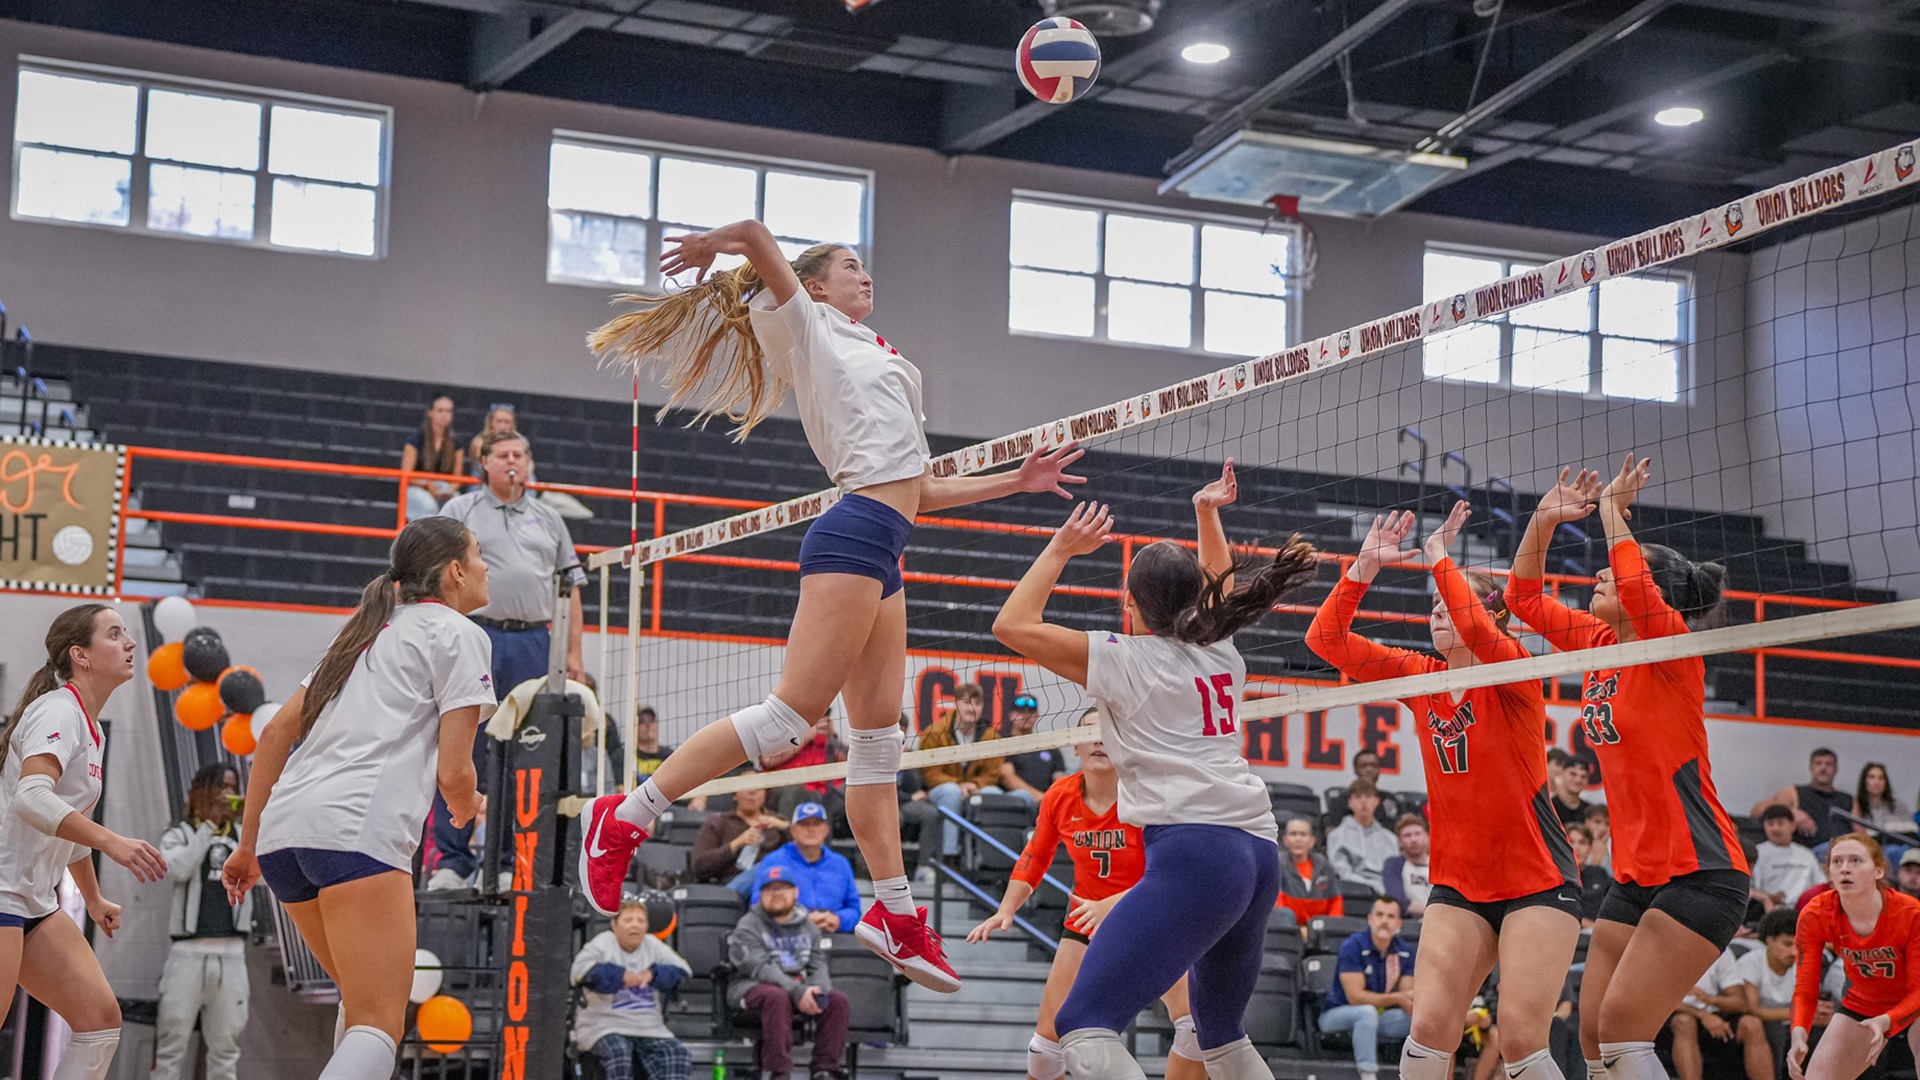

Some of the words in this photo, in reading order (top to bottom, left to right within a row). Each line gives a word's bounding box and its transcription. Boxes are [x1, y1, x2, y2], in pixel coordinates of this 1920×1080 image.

[1756, 189, 1788, 226] UNION
[1790, 171, 1846, 216] BULLDOGS
[1606, 242, 1636, 276] UNION
[1636, 226, 1685, 268] BULLDOGS
[1475, 284, 1502, 317] UNION
[1502, 272, 1545, 309] BULLDOGS
[1359, 325, 1383, 353] UNION
[1383, 312, 1420, 346] BULLDOGS
[1274, 347, 1310, 380] BULLDOGS
[1194, 672, 1237, 736] 15
[1582, 701, 1621, 746] 33
[1432, 730, 1469, 774] 17
[1072, 828, 1126, 850] UNION
[1090, 850, 1110, 878] 7
[502, 767, 543, 1080] UNION
